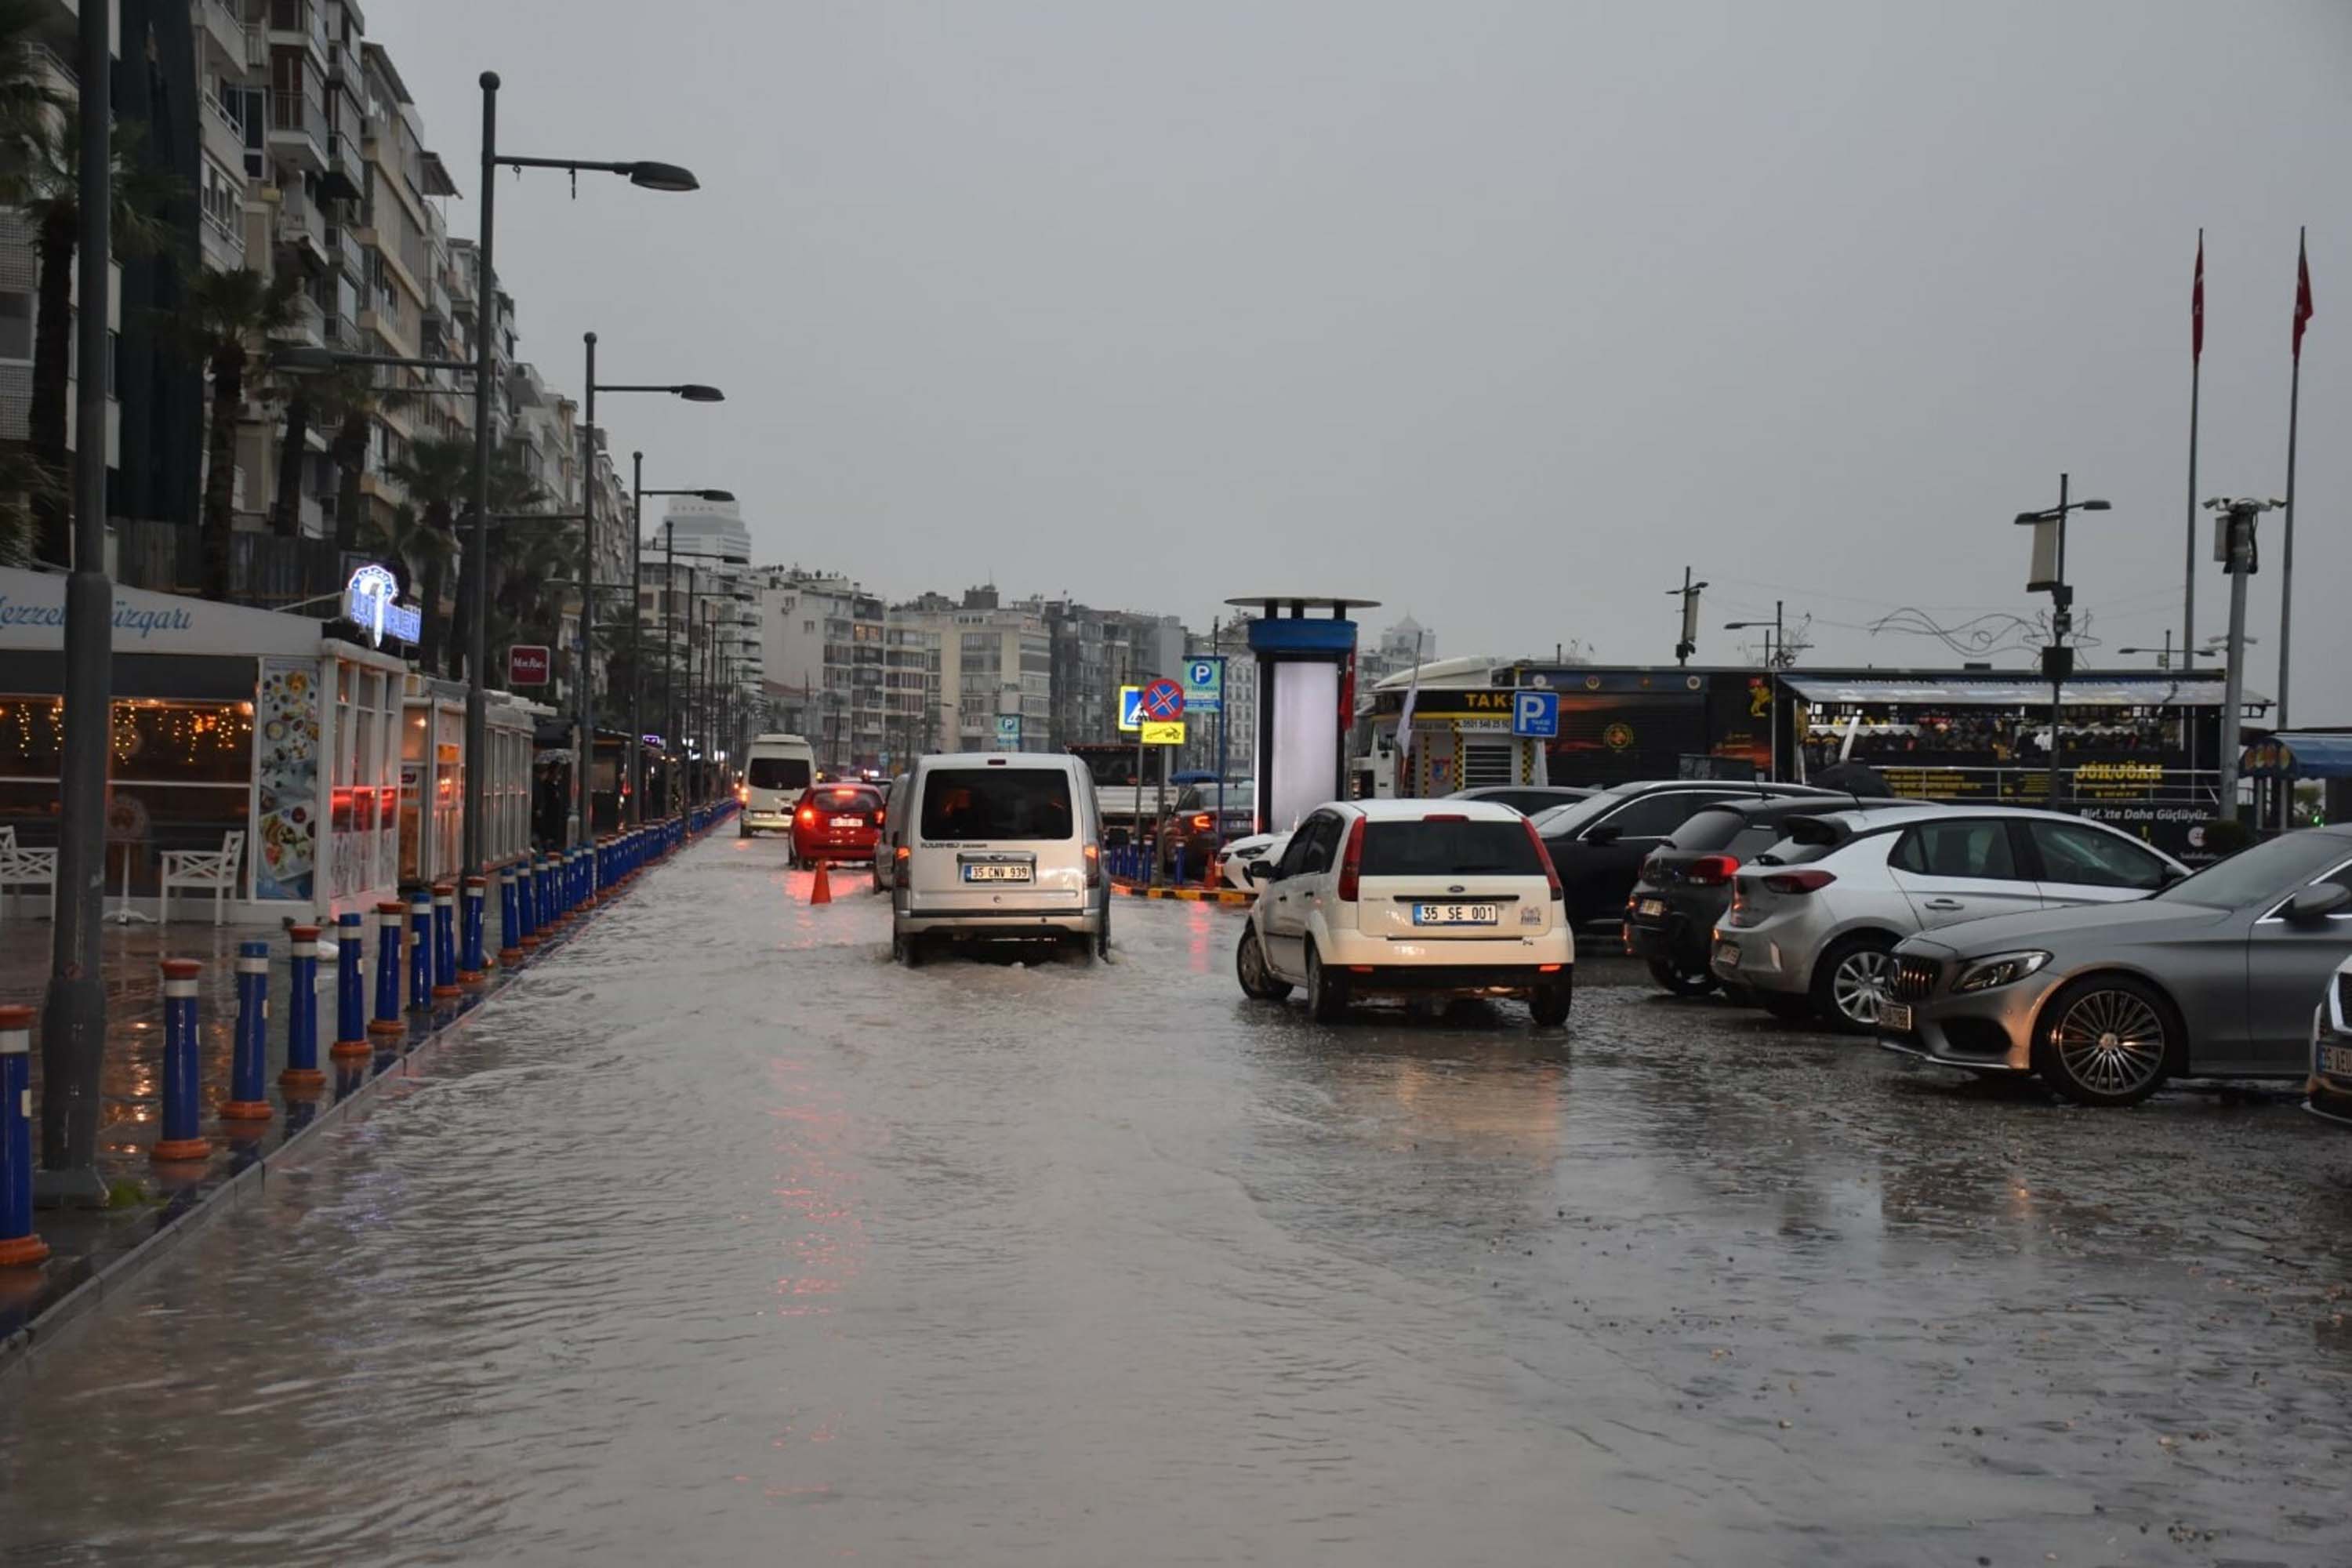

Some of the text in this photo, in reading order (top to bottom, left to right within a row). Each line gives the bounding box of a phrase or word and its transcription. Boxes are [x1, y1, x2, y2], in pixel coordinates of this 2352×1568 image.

[111, 601, 194, 639] üzgarı
[1196, 665, 1210, 682] P
[1519, 695, 1545, 731] P
[2081, 808, 2122, 820] Birlkte
[2124, 808, 2154, 820] Daha
[972, 867, 1028, 878] 35 CNV 939
[1423, 906, 1493, 920] 35 SE 001
